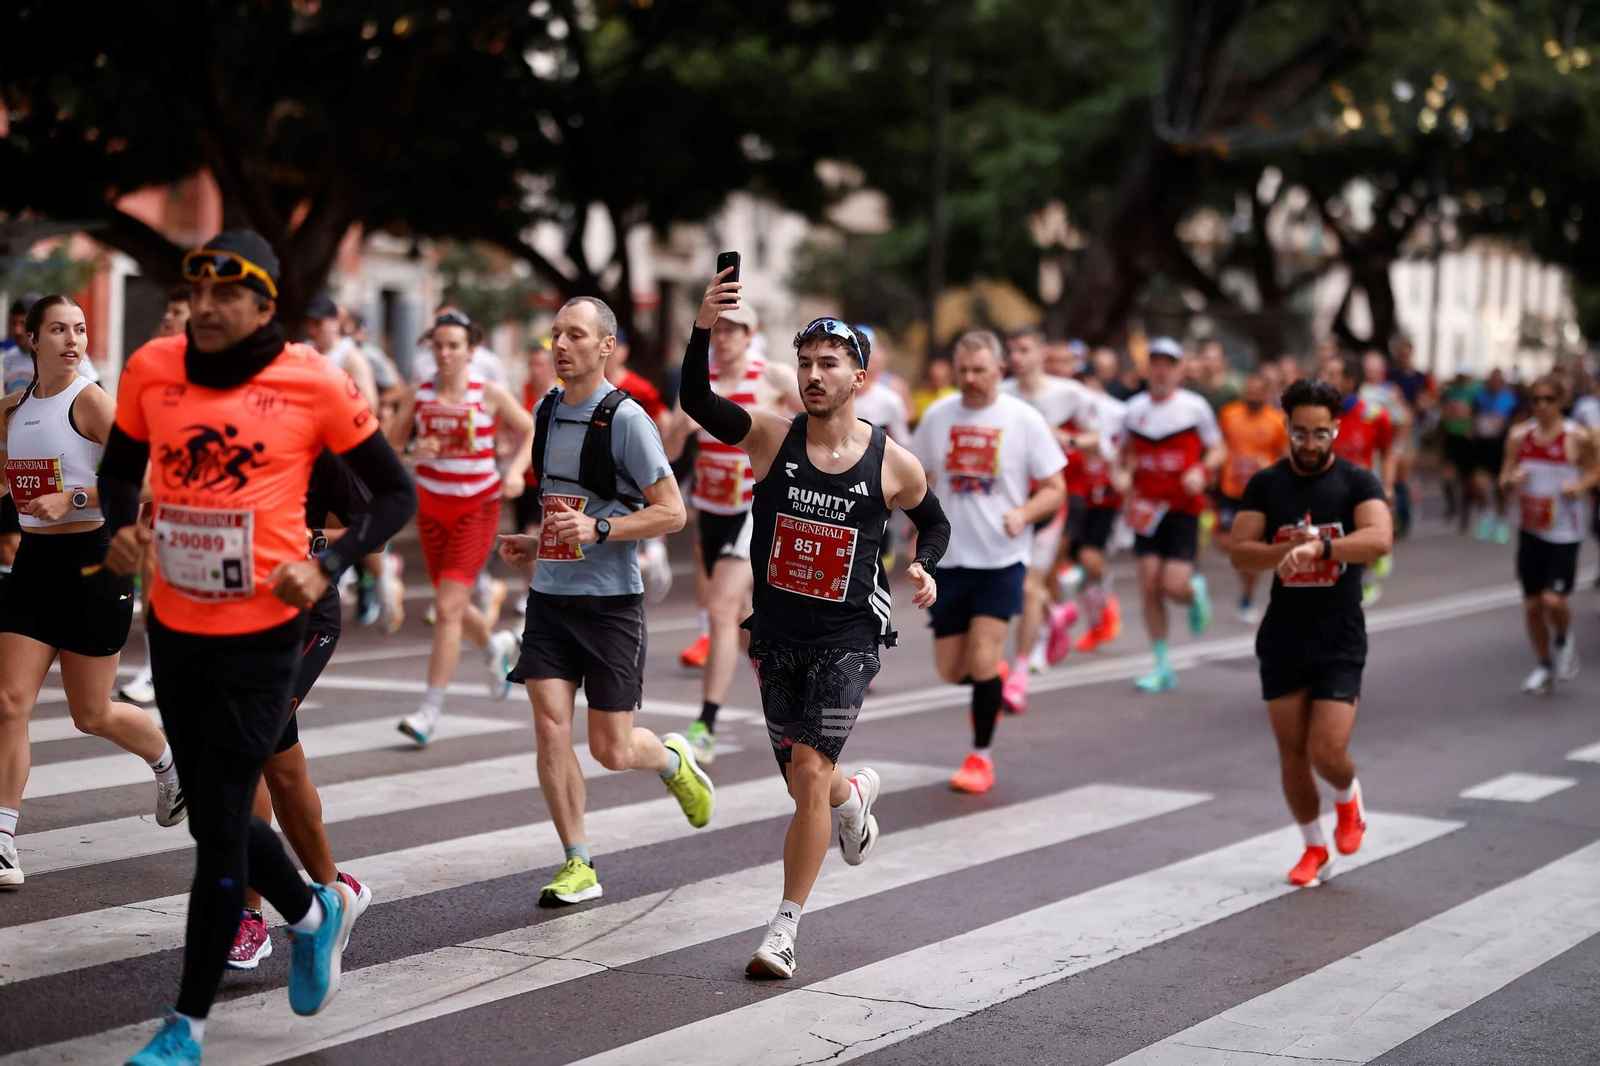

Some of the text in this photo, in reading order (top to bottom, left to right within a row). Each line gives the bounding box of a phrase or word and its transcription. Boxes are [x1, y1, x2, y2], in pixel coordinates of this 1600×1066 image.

[14, 460, 49, 470] GENERALI
[16, 476, 41, 489] 3273
[788, 486, 856, 513] RUNITY
[792, 501, 846, 521] RUN CLUB
[795, 521, 844, 539] GENERALI
[168, 531, 225, 552] 29089
[794, 538, 821, 555] 851
